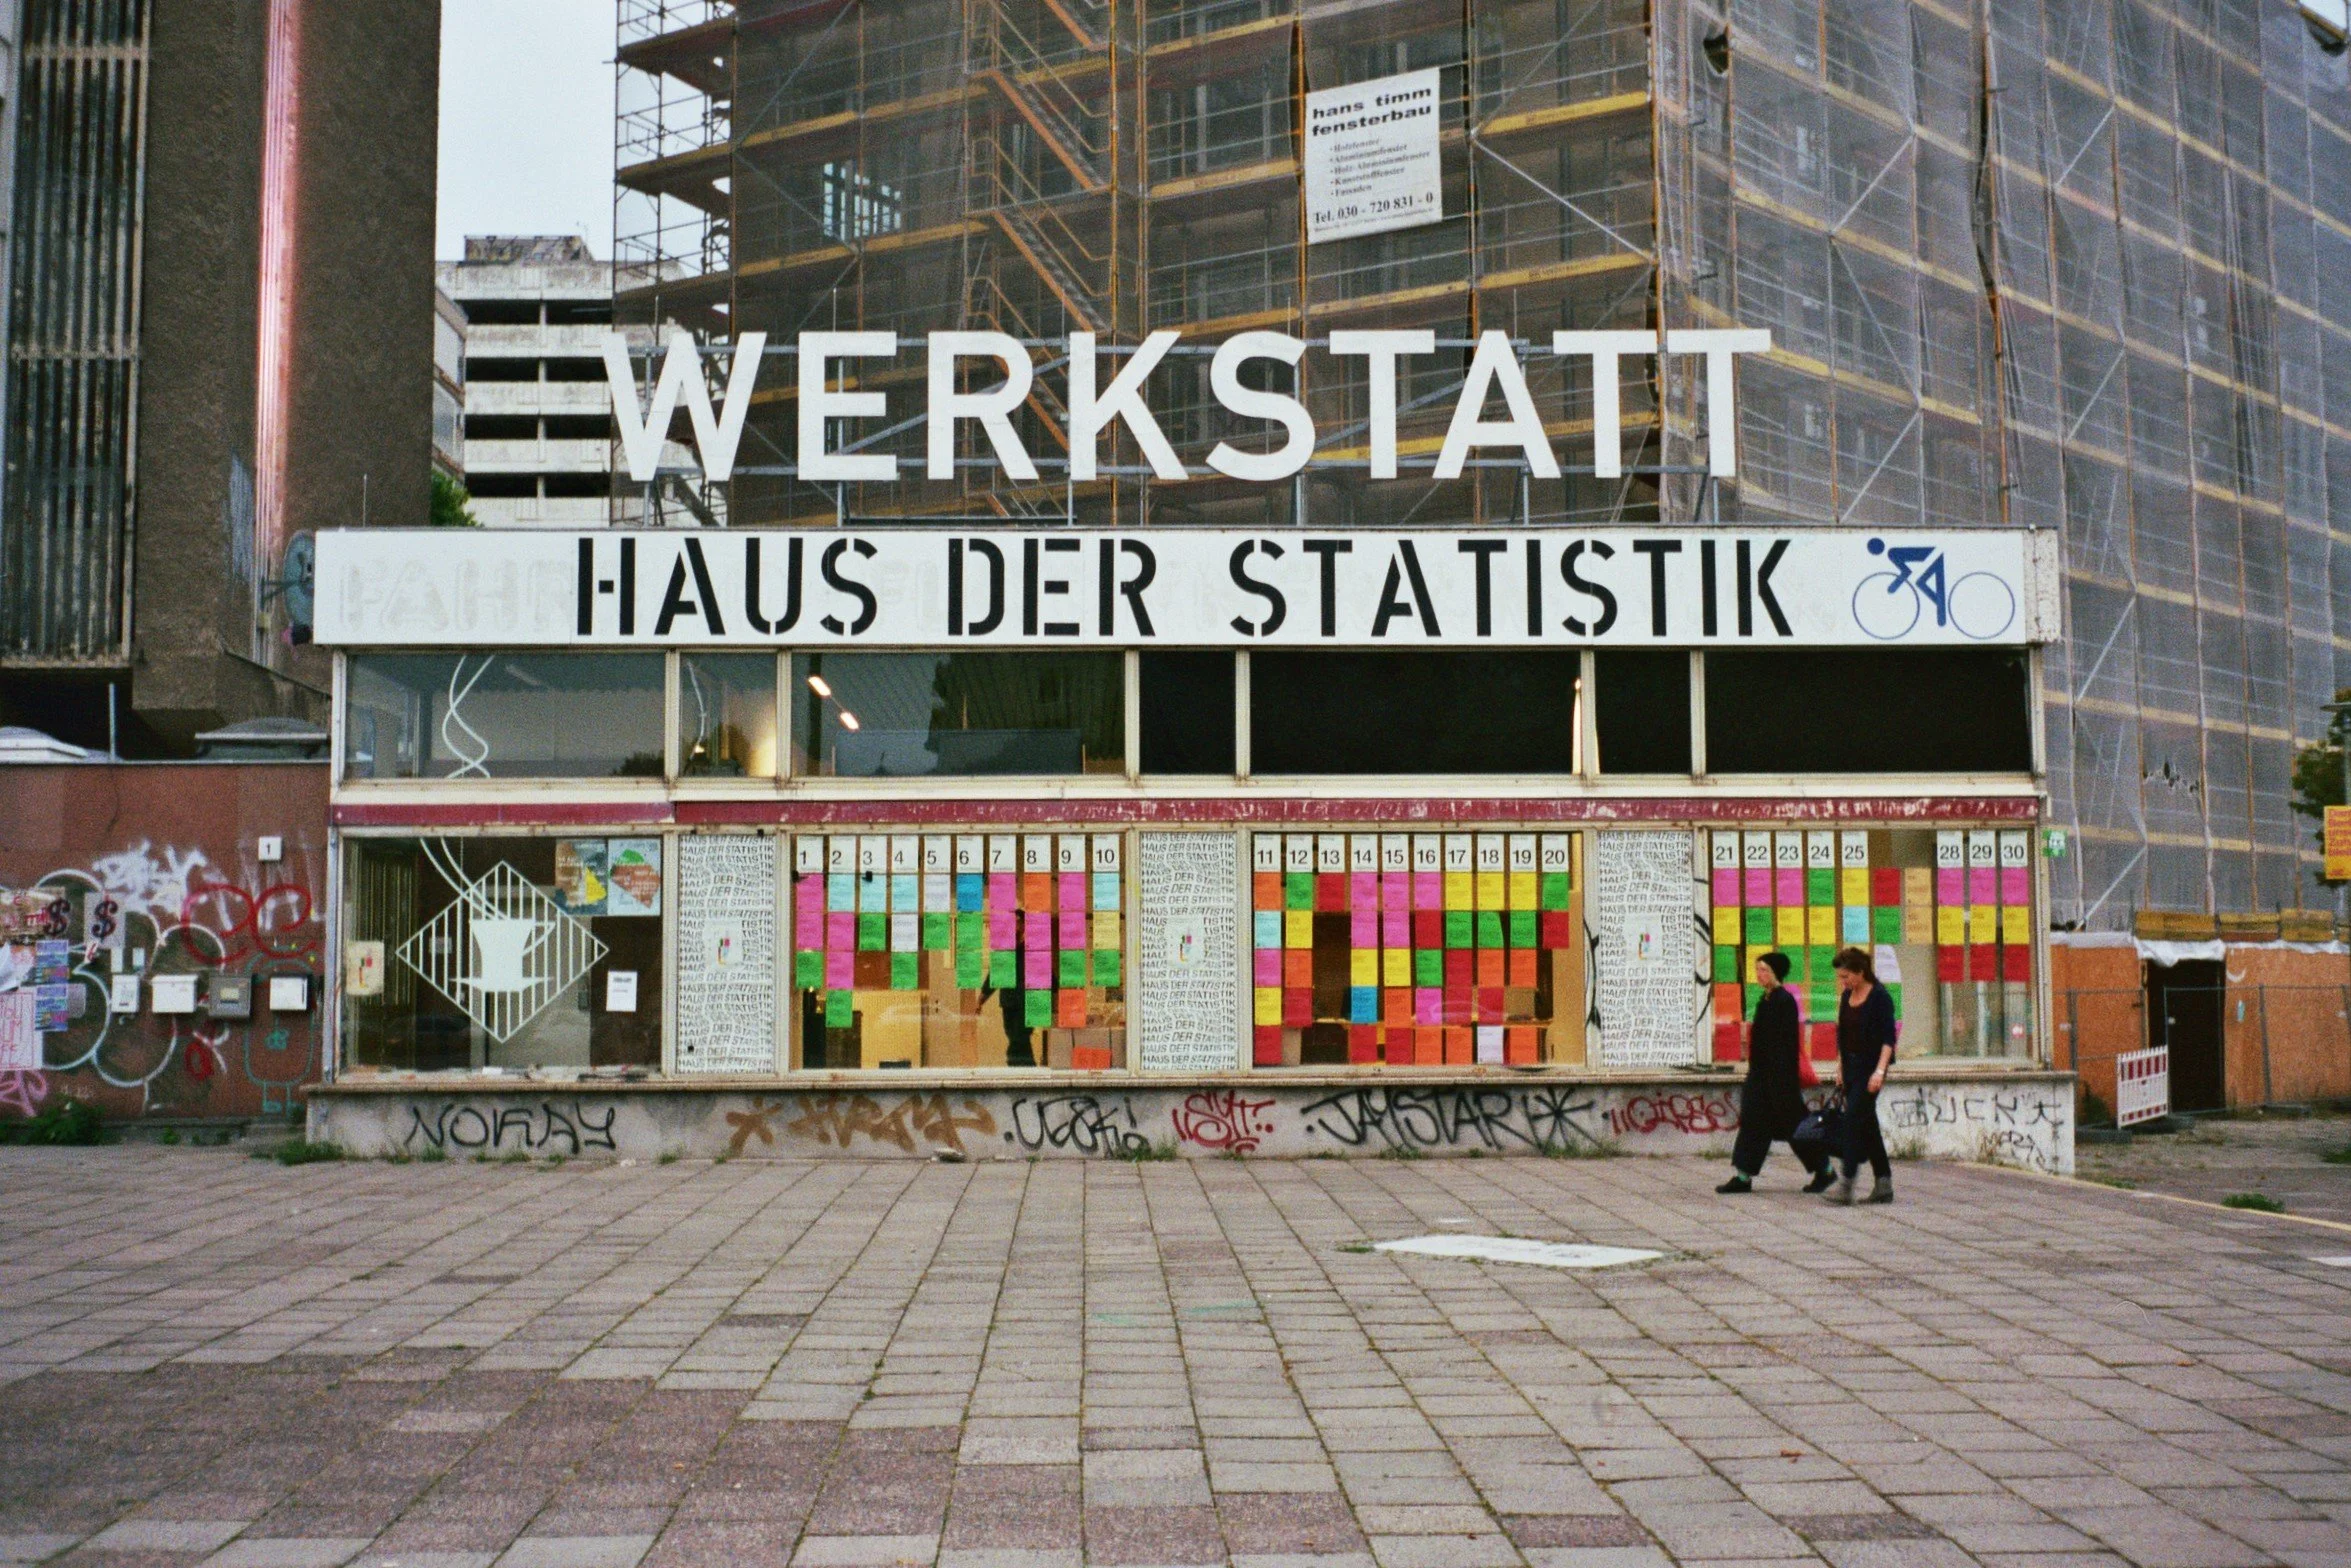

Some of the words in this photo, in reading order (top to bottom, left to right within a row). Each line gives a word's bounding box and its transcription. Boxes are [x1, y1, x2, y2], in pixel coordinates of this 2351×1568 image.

[1313, 102, 1364, 120] hans
[1375, 88, 1431, 107] timm
[1312, 105, 1431, 136] fensterbau
[1314, 210, 1335, 224] Tel.
[1337, 205, 1358, 219] 030
[1369, 200, 1391, 213] 720
[1393, 195, 1413, 209] 831
[602, 329, 1771, 482] WERKSTATT
[577, 538, 878, 637] HAUS
[948, 538, 1157, 637] DER
[1229, 538, 1793, 638] STATISTIK
[1143, 843, 1166, 852] HAUS
[1169, 843, 1185, 851] DER
[1715, 845, 1733, 861] 21
[1746, 845, 1768, 861] 22
[1778, 845, 1799, 860] 23
[1811, 845, 1830, 860] 24
[1844, 845, 1865, 860] 25
[1939, 845, 1960, 860] 28
[1971, 844, 1993, 860] 29
[2003, 845, 2025, 860] 30
[800, 850, 807, 865] 1
[831, 850, 842, 865] 2
[862, 850, 873, 865] 3
[894, 850, 904, 864] 4
[927, 850, 937, 865] 5
[958, 850, 970, 865] 6
[992, 849, 1002, 865] 7
[1026, 849, 1037, 865] 8
[1060, 849, 1072, 864] 9
[1096, 848, 1115, 864] 10
[1257, 849, 1273, 865] 11
[1290, 849, 1308, 865] 12
[1321, 849, 1340, 865] 13
[1353, 849, 1372, 864] 14
[1385, 849, 1404, 865] 15
[1417, 849, 1436, 865] 16
[1448, 849, 1467, 864] 17
[1480, 849, 1500, 864] 18
[1513, 849, 1532, 865] 19
[1544, 849, 1566, 865] 20
[1143, 907, 1168, 915] HAUS
[1171, 907, 1188, 915] DER
